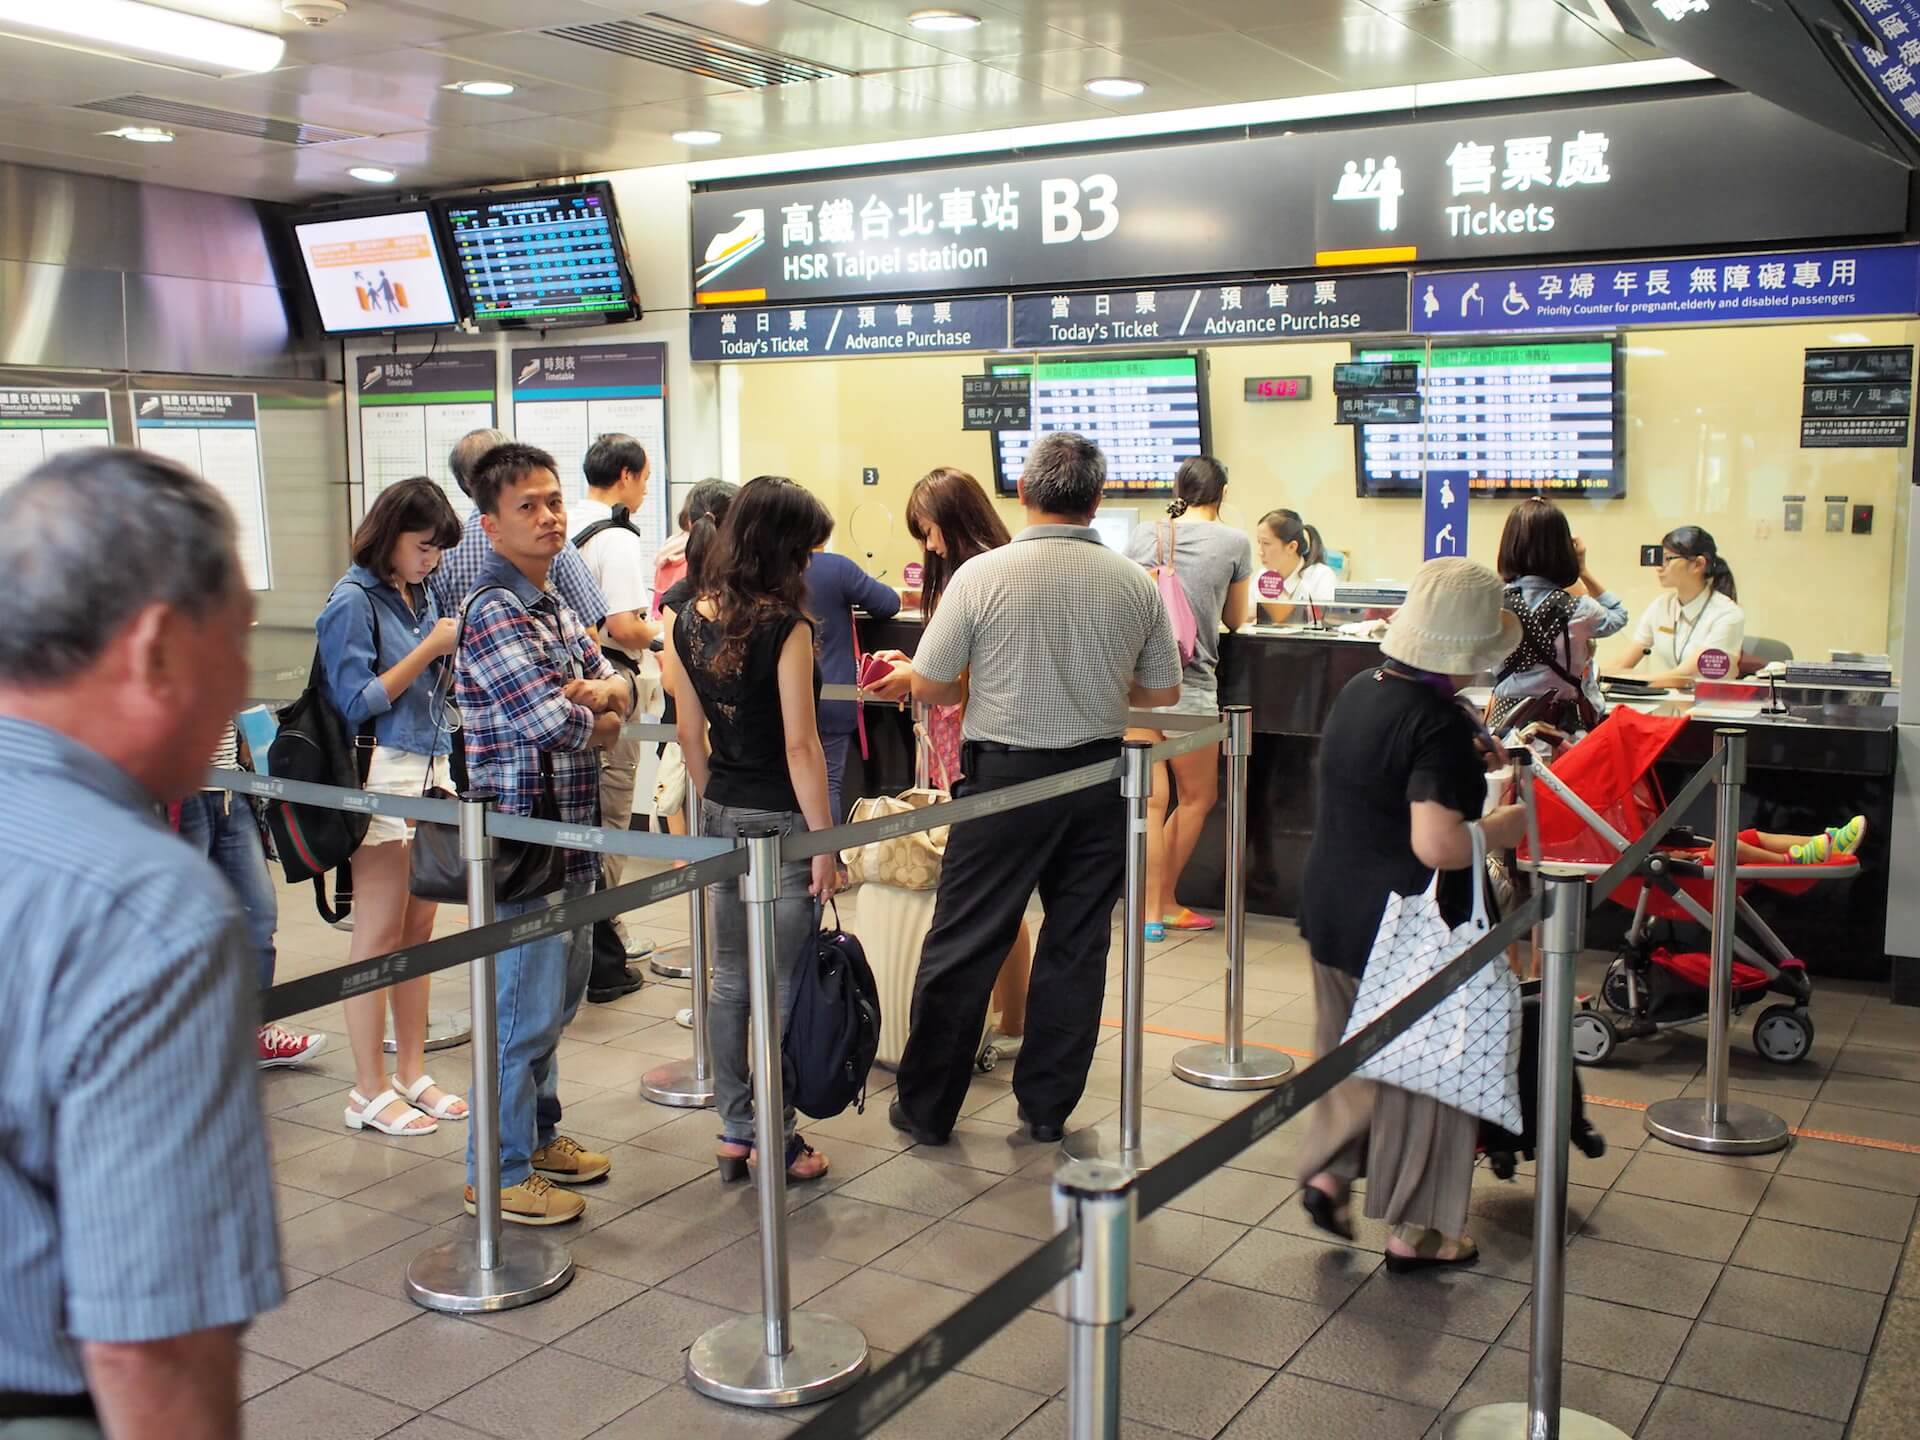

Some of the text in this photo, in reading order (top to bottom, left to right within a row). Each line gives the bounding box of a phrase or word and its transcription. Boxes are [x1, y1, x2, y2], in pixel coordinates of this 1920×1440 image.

[1446, 130, 1611, 196] 售票處
[781, 182, 1020, 248] 高鐵台北車站
[1041, 173, 1119, 244] B3
[1445, 202, 1555, 237] Tickets
[783, 243, 987, 281] HSR Taipei station
[1538, 259, 1856, 300] 孕婦 年長 無障礙專用
[1050, 290, 1156, 319] 當日票
[1220, 279, 1337, 311] 預售票
[1537, 304, 1571, 317] Priority
[1574, 303, 1612, 315] Counter
[1615, 302, 1629, 313] for
[1718, 297, 1738, 309] and
[1741, 294, 1789, 307] disabled
[1791, 293, 1856, 307] passengers
[720, 310, 807, 335] 當日票
[857, 301, 952, 329] 預售票
[1112, 320, 1159, 339] Ticket
[1204, 316, 1276, 335] Advance
[1281, 311, 1361, 331] Purchase
[770, 336, 809, 353] Ticket
[845, 332, 904, 349] Advance
[906, 329, 972, 347] Purchase
[544, 356, 576, 371] 時刻表
[545, 372, 576, 382] Timetable
[866, 470, 874, 483] 3
[1648, 548, 1655, 564] 1
